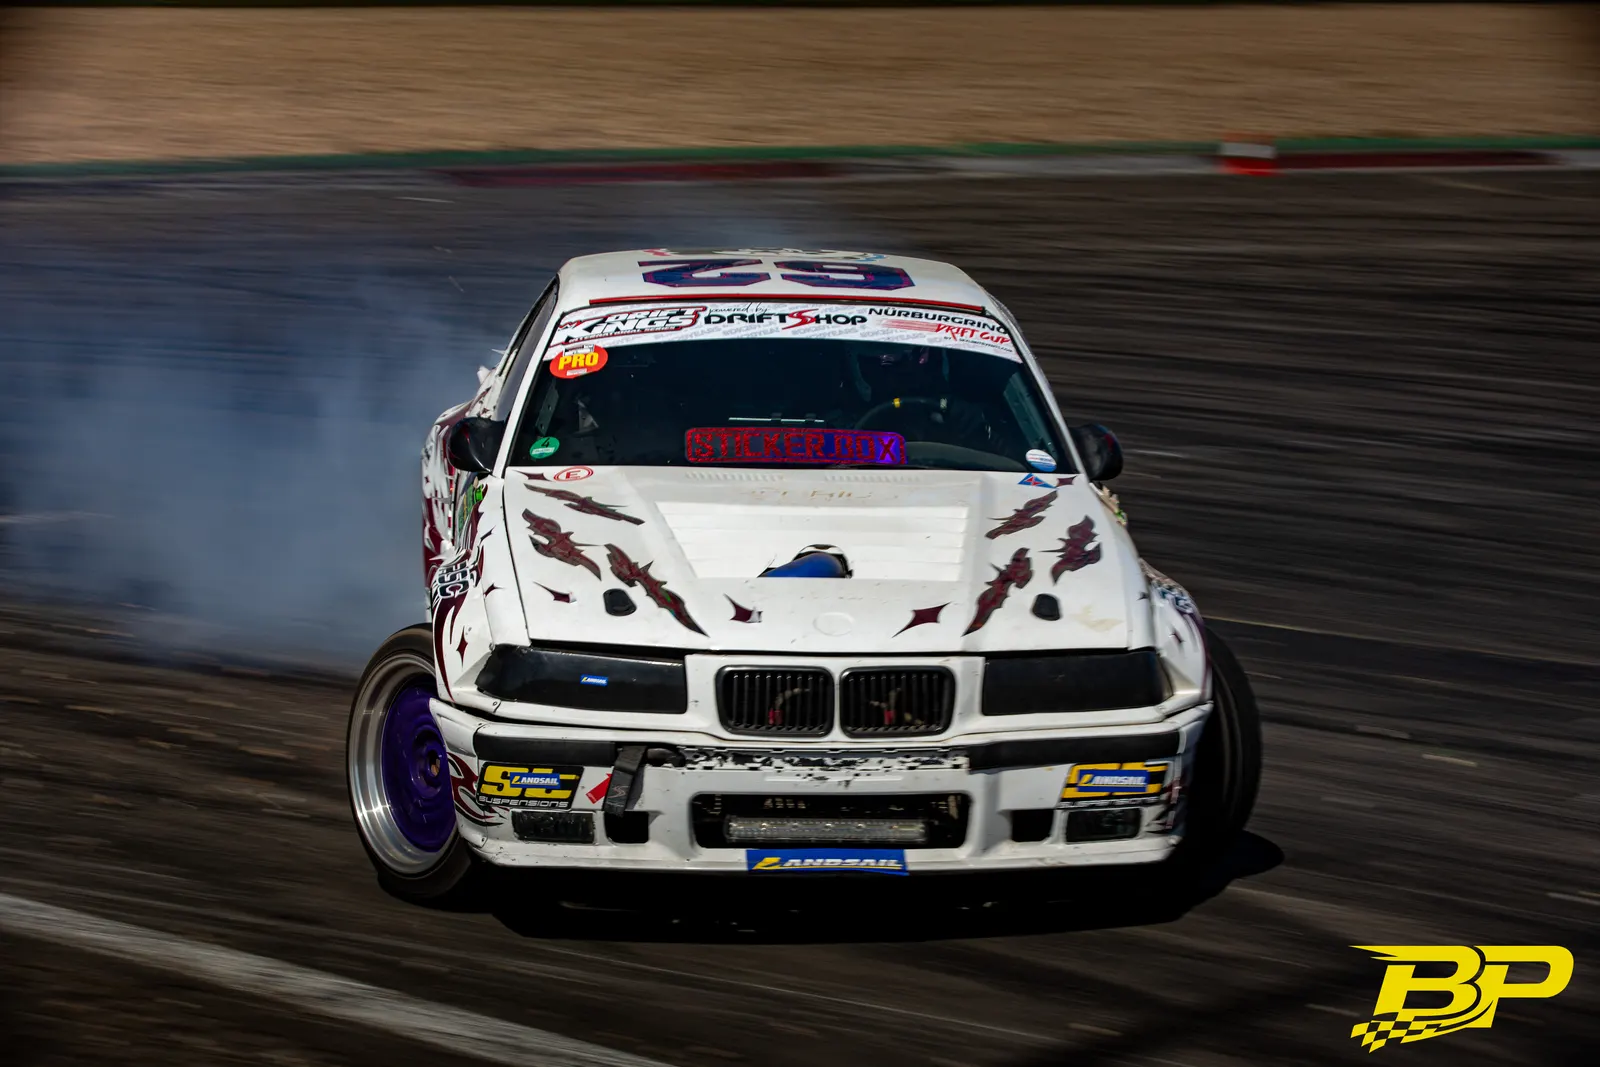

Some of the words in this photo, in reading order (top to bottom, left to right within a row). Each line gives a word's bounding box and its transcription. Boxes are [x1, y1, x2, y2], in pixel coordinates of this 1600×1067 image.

[604, 307, 704, 323] DRIFT
[552, 314, 698, 346] KINGS
[935, 323, 980, 342] DRIFT
[980, 331, 1011, 344] CUP
[558, 352, 599, 370] PRO
[541, 437, 551, 448] 4
[694, 433, 897, 462] STICKER.BOX
[565, 470, 582, 480] E
[511, 775, 559, 785] LANDSAIL
[479, 796, 569, 808] SUSPENSIONS
[752, 852, 904, 870] LANDSAIL
